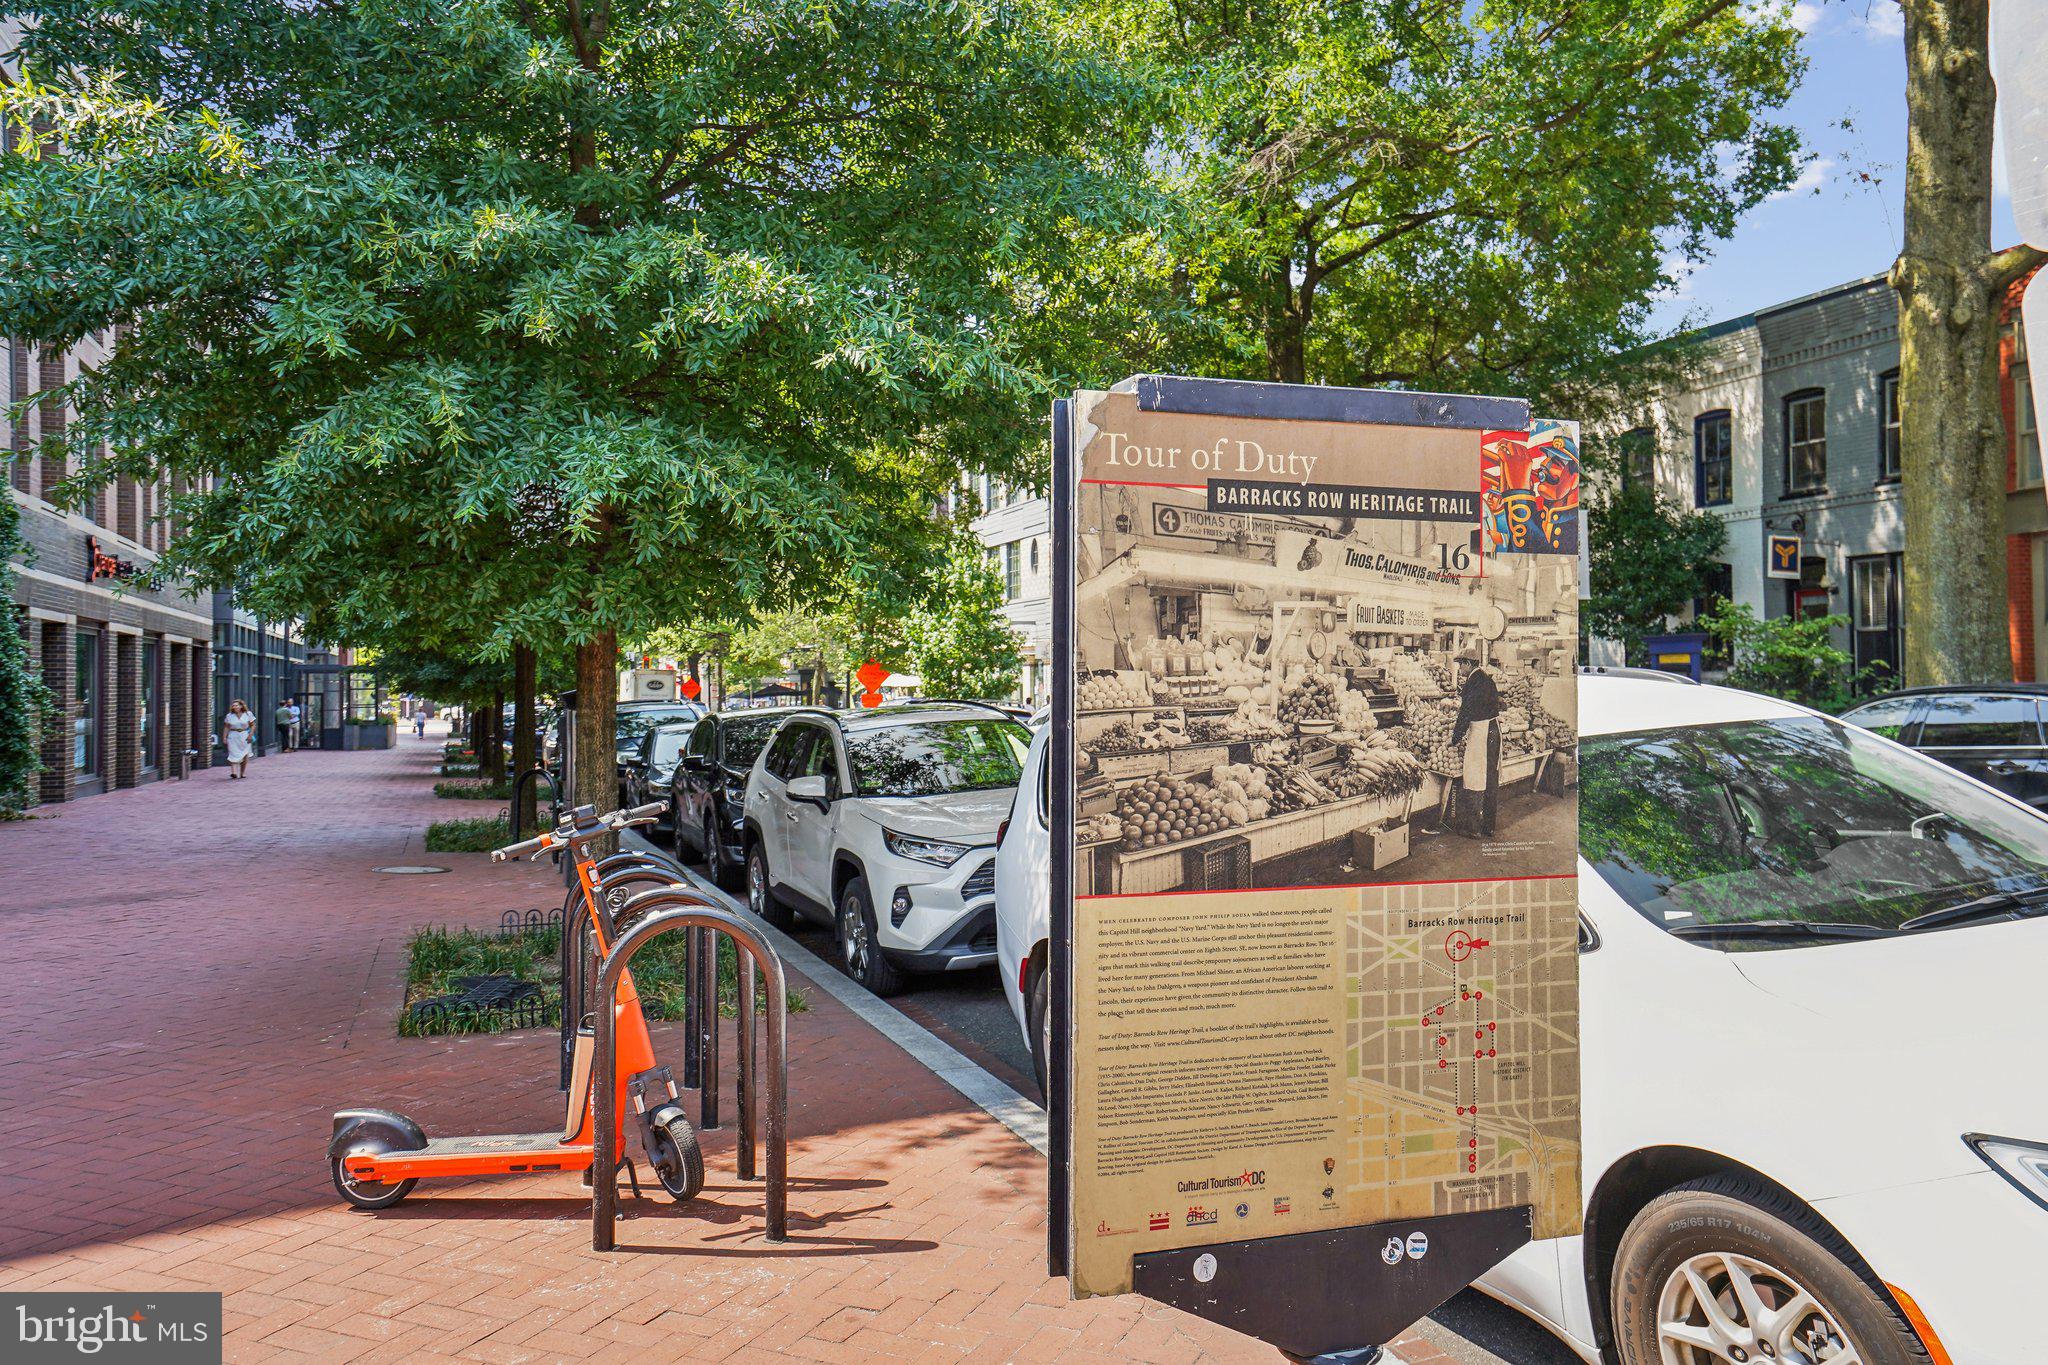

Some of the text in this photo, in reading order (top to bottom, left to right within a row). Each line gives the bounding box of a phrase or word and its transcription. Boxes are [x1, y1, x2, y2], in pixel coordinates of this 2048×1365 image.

[1100, 432, 1318, 486] Tour of Duty
[1216, 486, 1473, 516] BARRACKS ROW HERITAGE TRAIL
[1162, 510, 1175, 531] 4
[1182, 511, 1225, 528] THOMAS
[1438, 543, 1470, 570] 16
[1376, 554, 1427, 580] CALOMIRIS
[1426, 572, 1440, 582] and
[1356, 604, 1404, 626] FRUIT BASKETS
[1301, 908, 1318, 916] people
[1408, 913, 1525, 928] Barracks Row Heritage Trail
[1109, 928, 1129, 937] Capitol
[1142, 926, 1177, 935] neighborhood
[1266, 931, 1287, 940] pleasant
[1149, 972, 1180, 980] generations.
[1297, 1028, 1334, 1037] neighborhoods.
[1177, 1170, 1265, 1193] Cultural Tourism DC
[1668, 1217, 1771, 1243] 235/65 R17 104H
